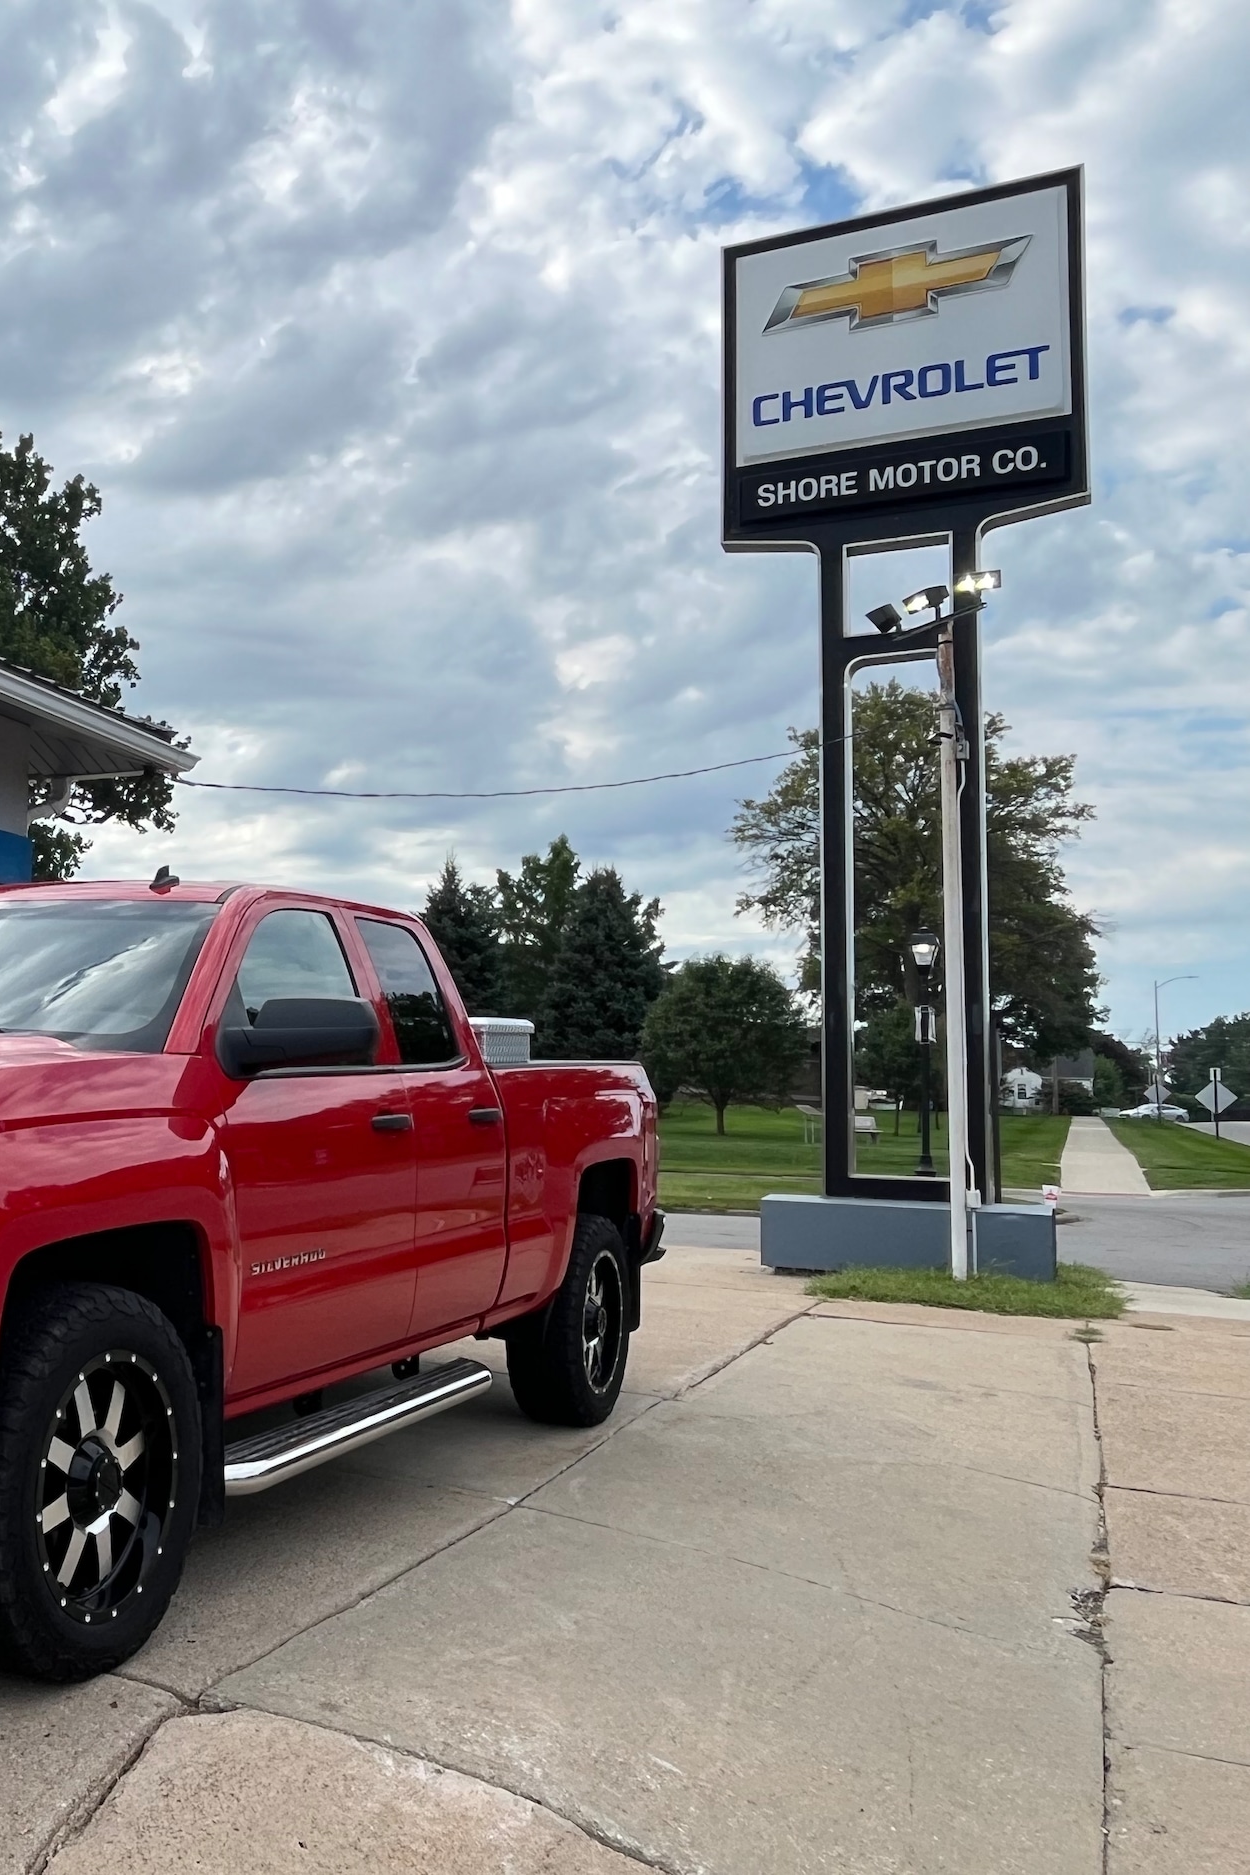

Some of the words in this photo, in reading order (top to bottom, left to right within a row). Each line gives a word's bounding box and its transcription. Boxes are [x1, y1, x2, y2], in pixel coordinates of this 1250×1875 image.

[752, 345, 1050, 427] CHEVROLET
[757, 471, 858, 507] SHORE
[868, 454, 981, 491] MOTOR
[991, 445, 1047, 474] CO.
